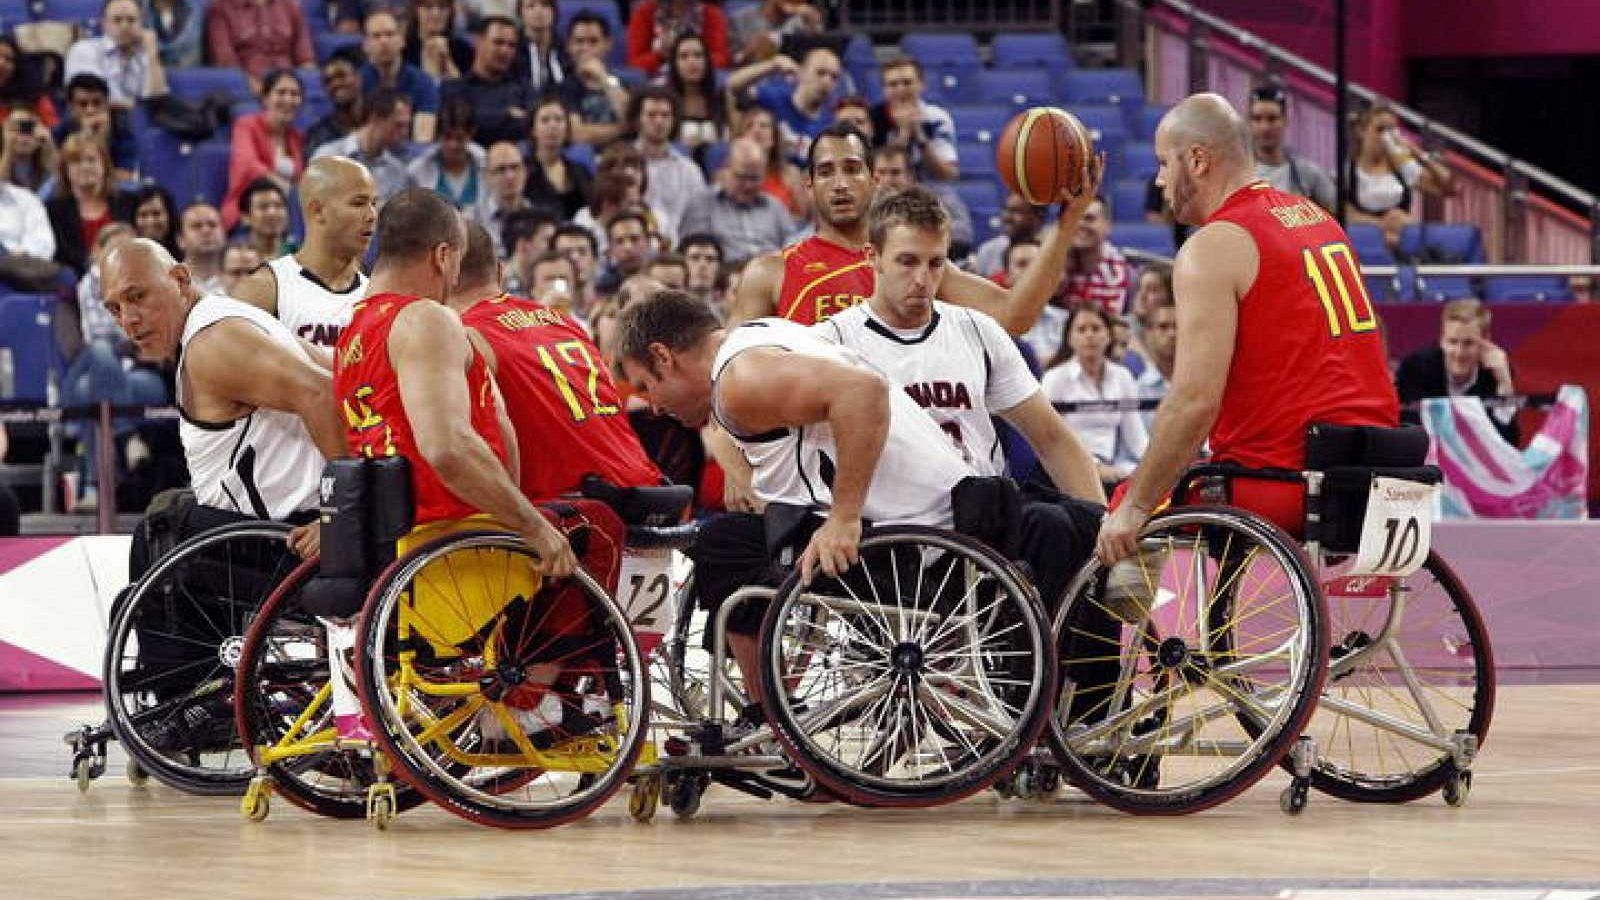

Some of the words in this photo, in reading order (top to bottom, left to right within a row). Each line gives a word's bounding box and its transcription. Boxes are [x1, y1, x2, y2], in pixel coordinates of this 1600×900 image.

[1302, 243, 1376, 337] 10
[536, 341, 619, 421] 12
[1371, 516, 1420, 572] 10
[626, 573, 670, 626] 12
